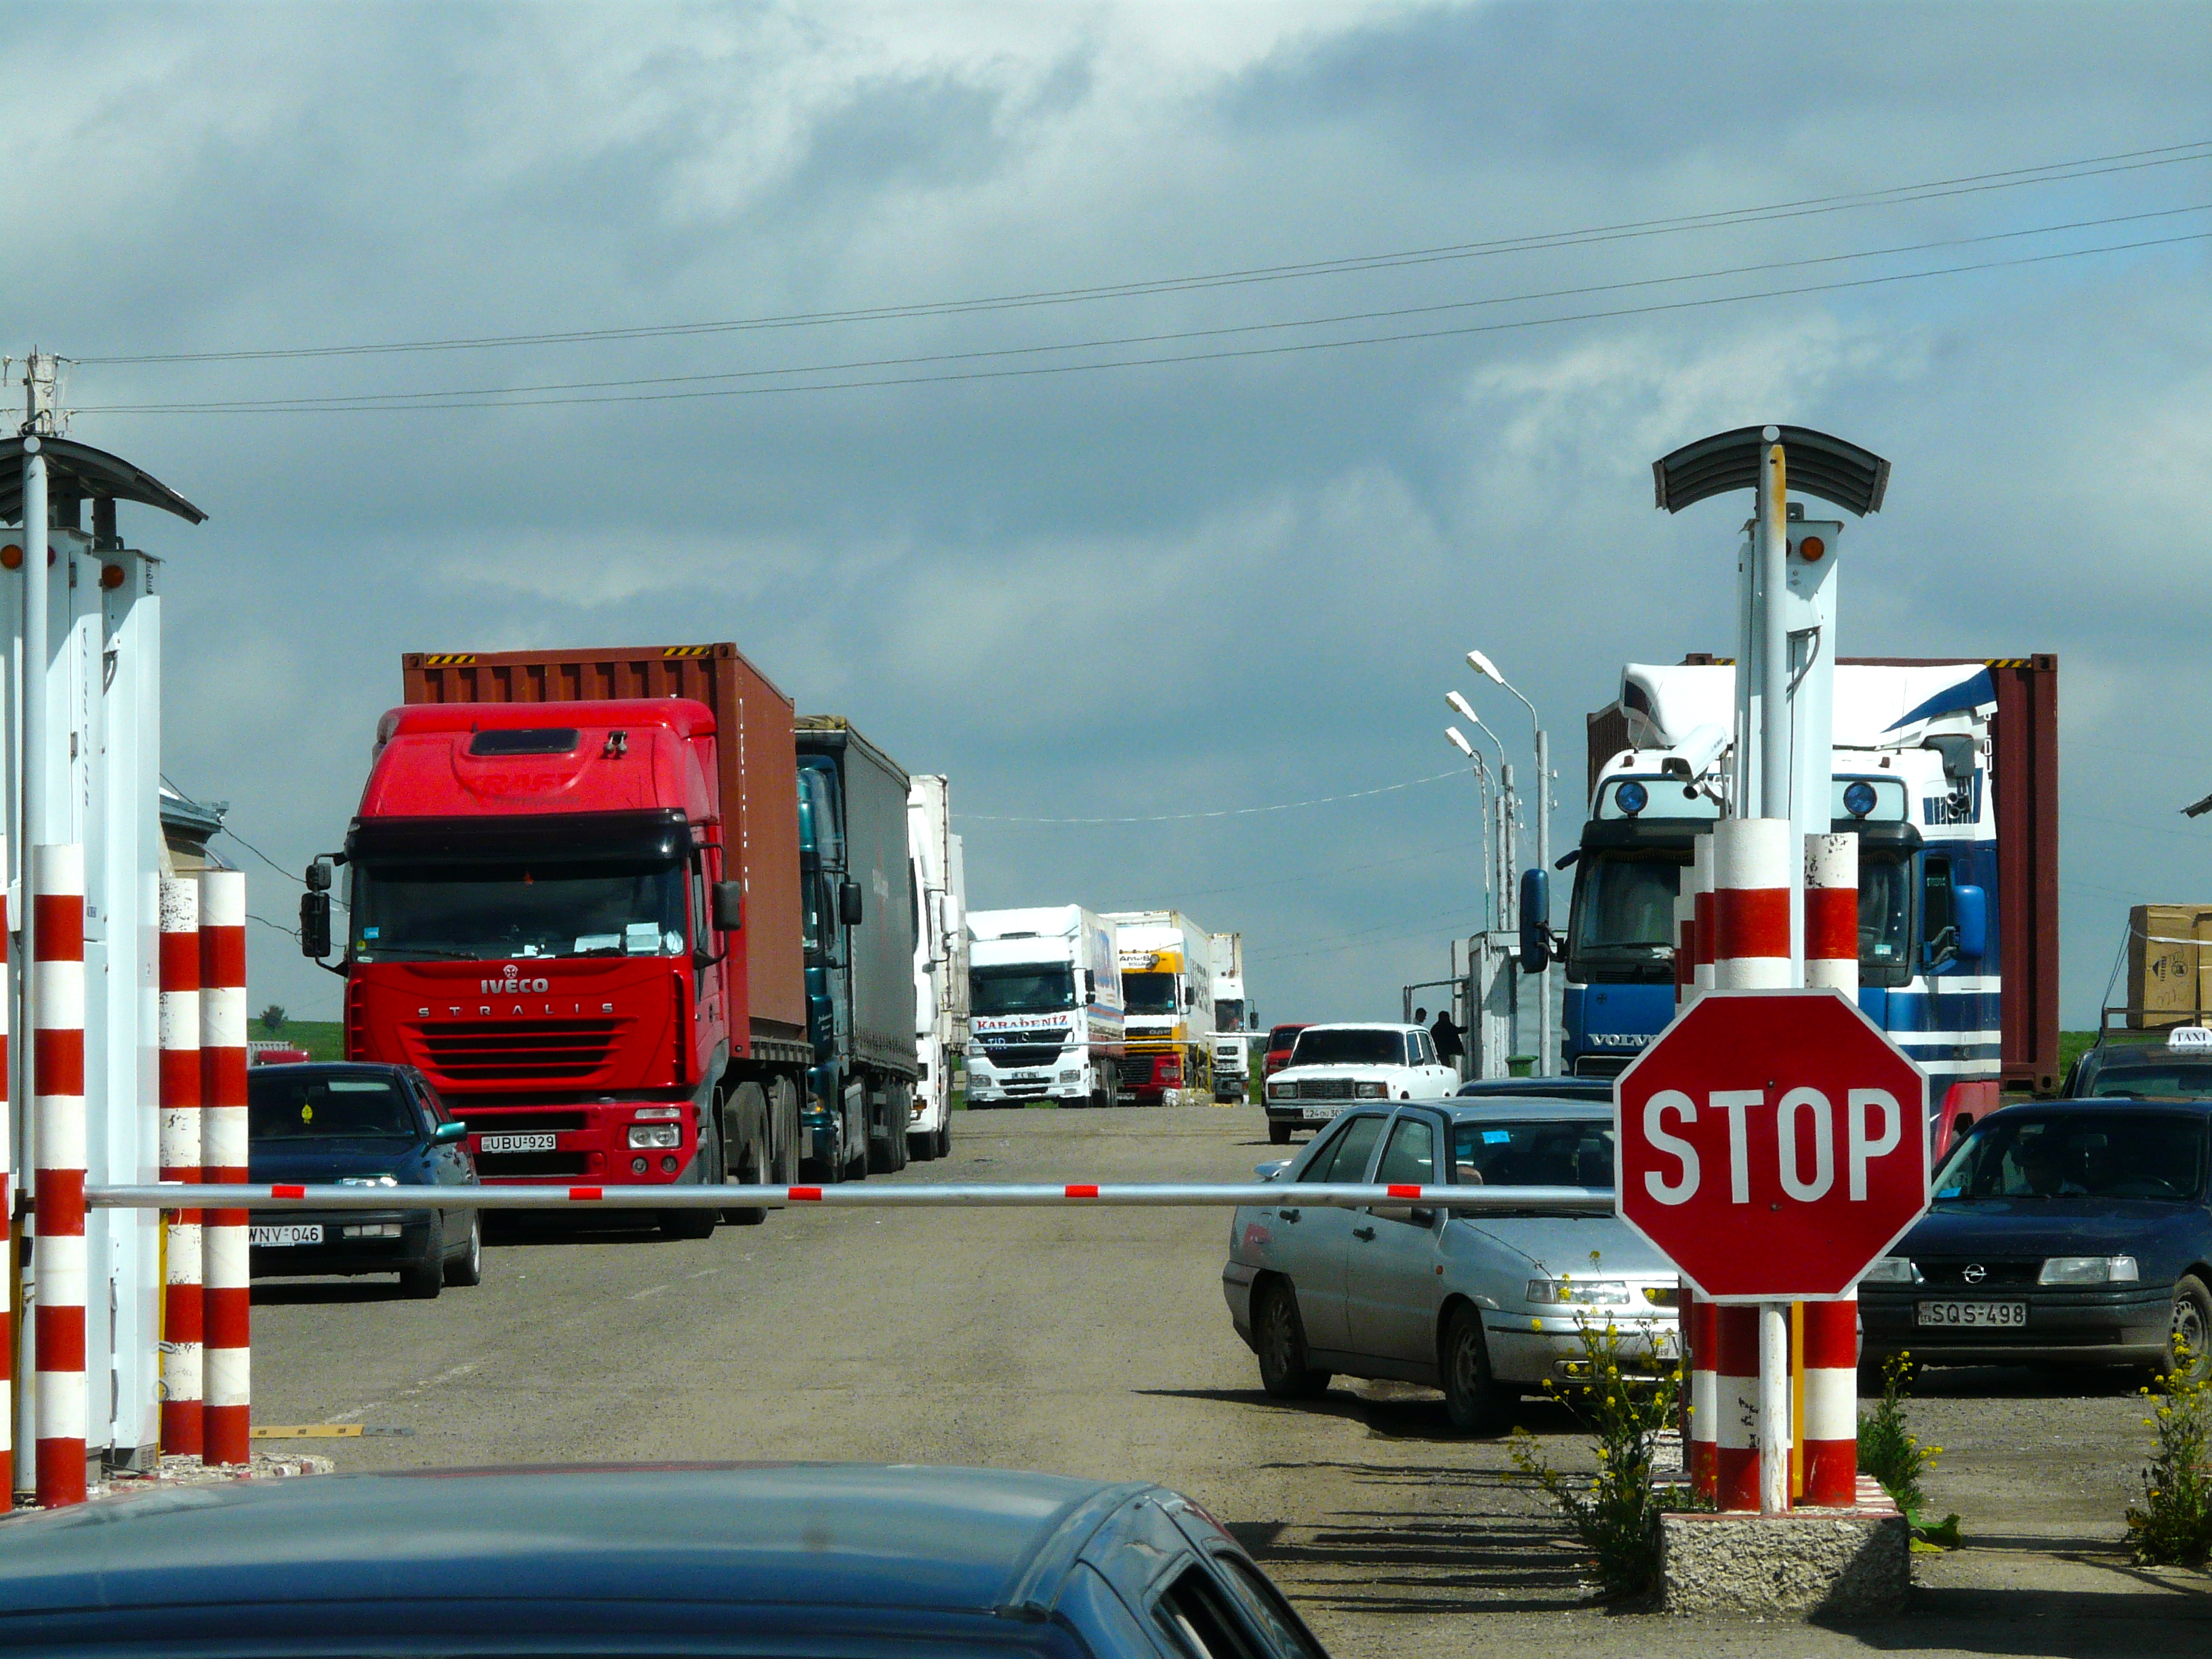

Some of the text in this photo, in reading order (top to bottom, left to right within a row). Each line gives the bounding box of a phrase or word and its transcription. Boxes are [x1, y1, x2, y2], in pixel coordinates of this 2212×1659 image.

[481, 979, 548, 994] IVECO
[418, 1003, 613, 1017] STRALIS
[2175, 1032, 2207, 1042] TAXI
[491, 1136, 554, 1149] UBU-929
[1643, 1087, 1901, 1205] STOP
[1932, 1304, 2024, 1324] SQS-498
